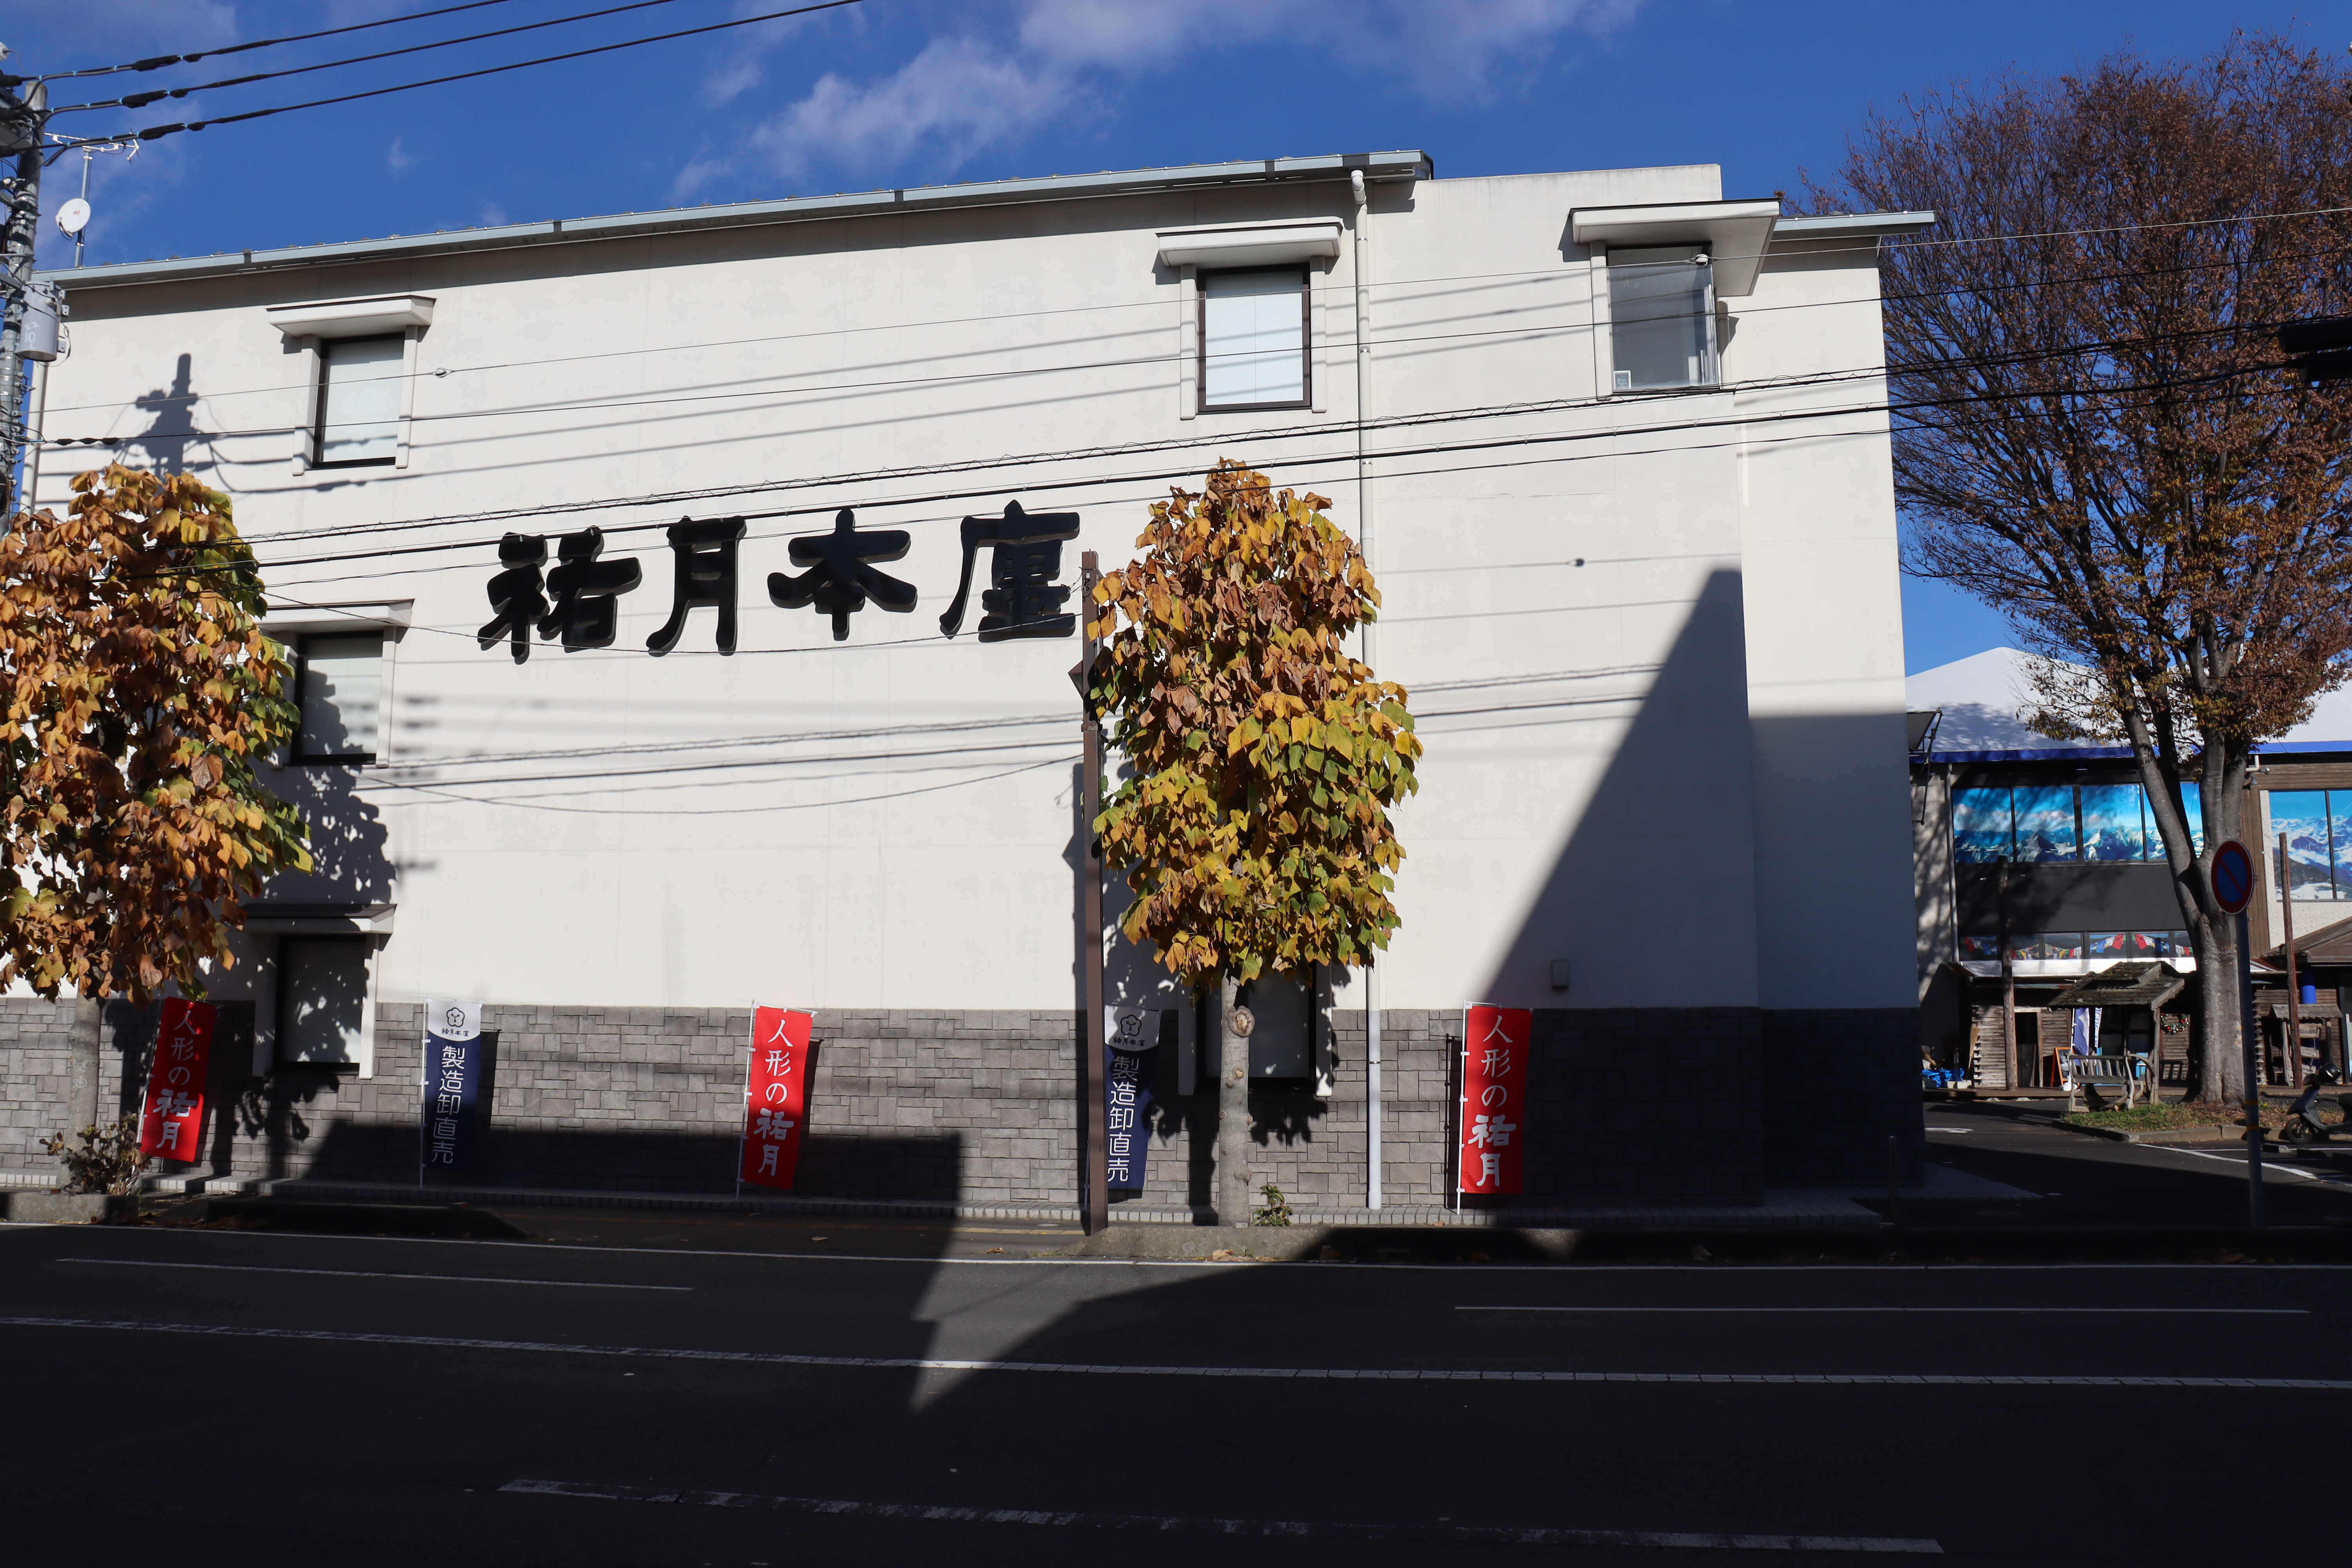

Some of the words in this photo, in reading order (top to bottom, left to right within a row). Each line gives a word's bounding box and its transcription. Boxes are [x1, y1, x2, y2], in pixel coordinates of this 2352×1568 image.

[153, 1010, 198, 1150] 人形の祐月
[432, 1045, 465, 1163] 製造卸直売
[754, 1019, 794, 1176] 人形の祐月
[1107, 1056, 1140, 1182] 製造卸直売
[1468, 1015, 1517, 1187] 人形の祐月
